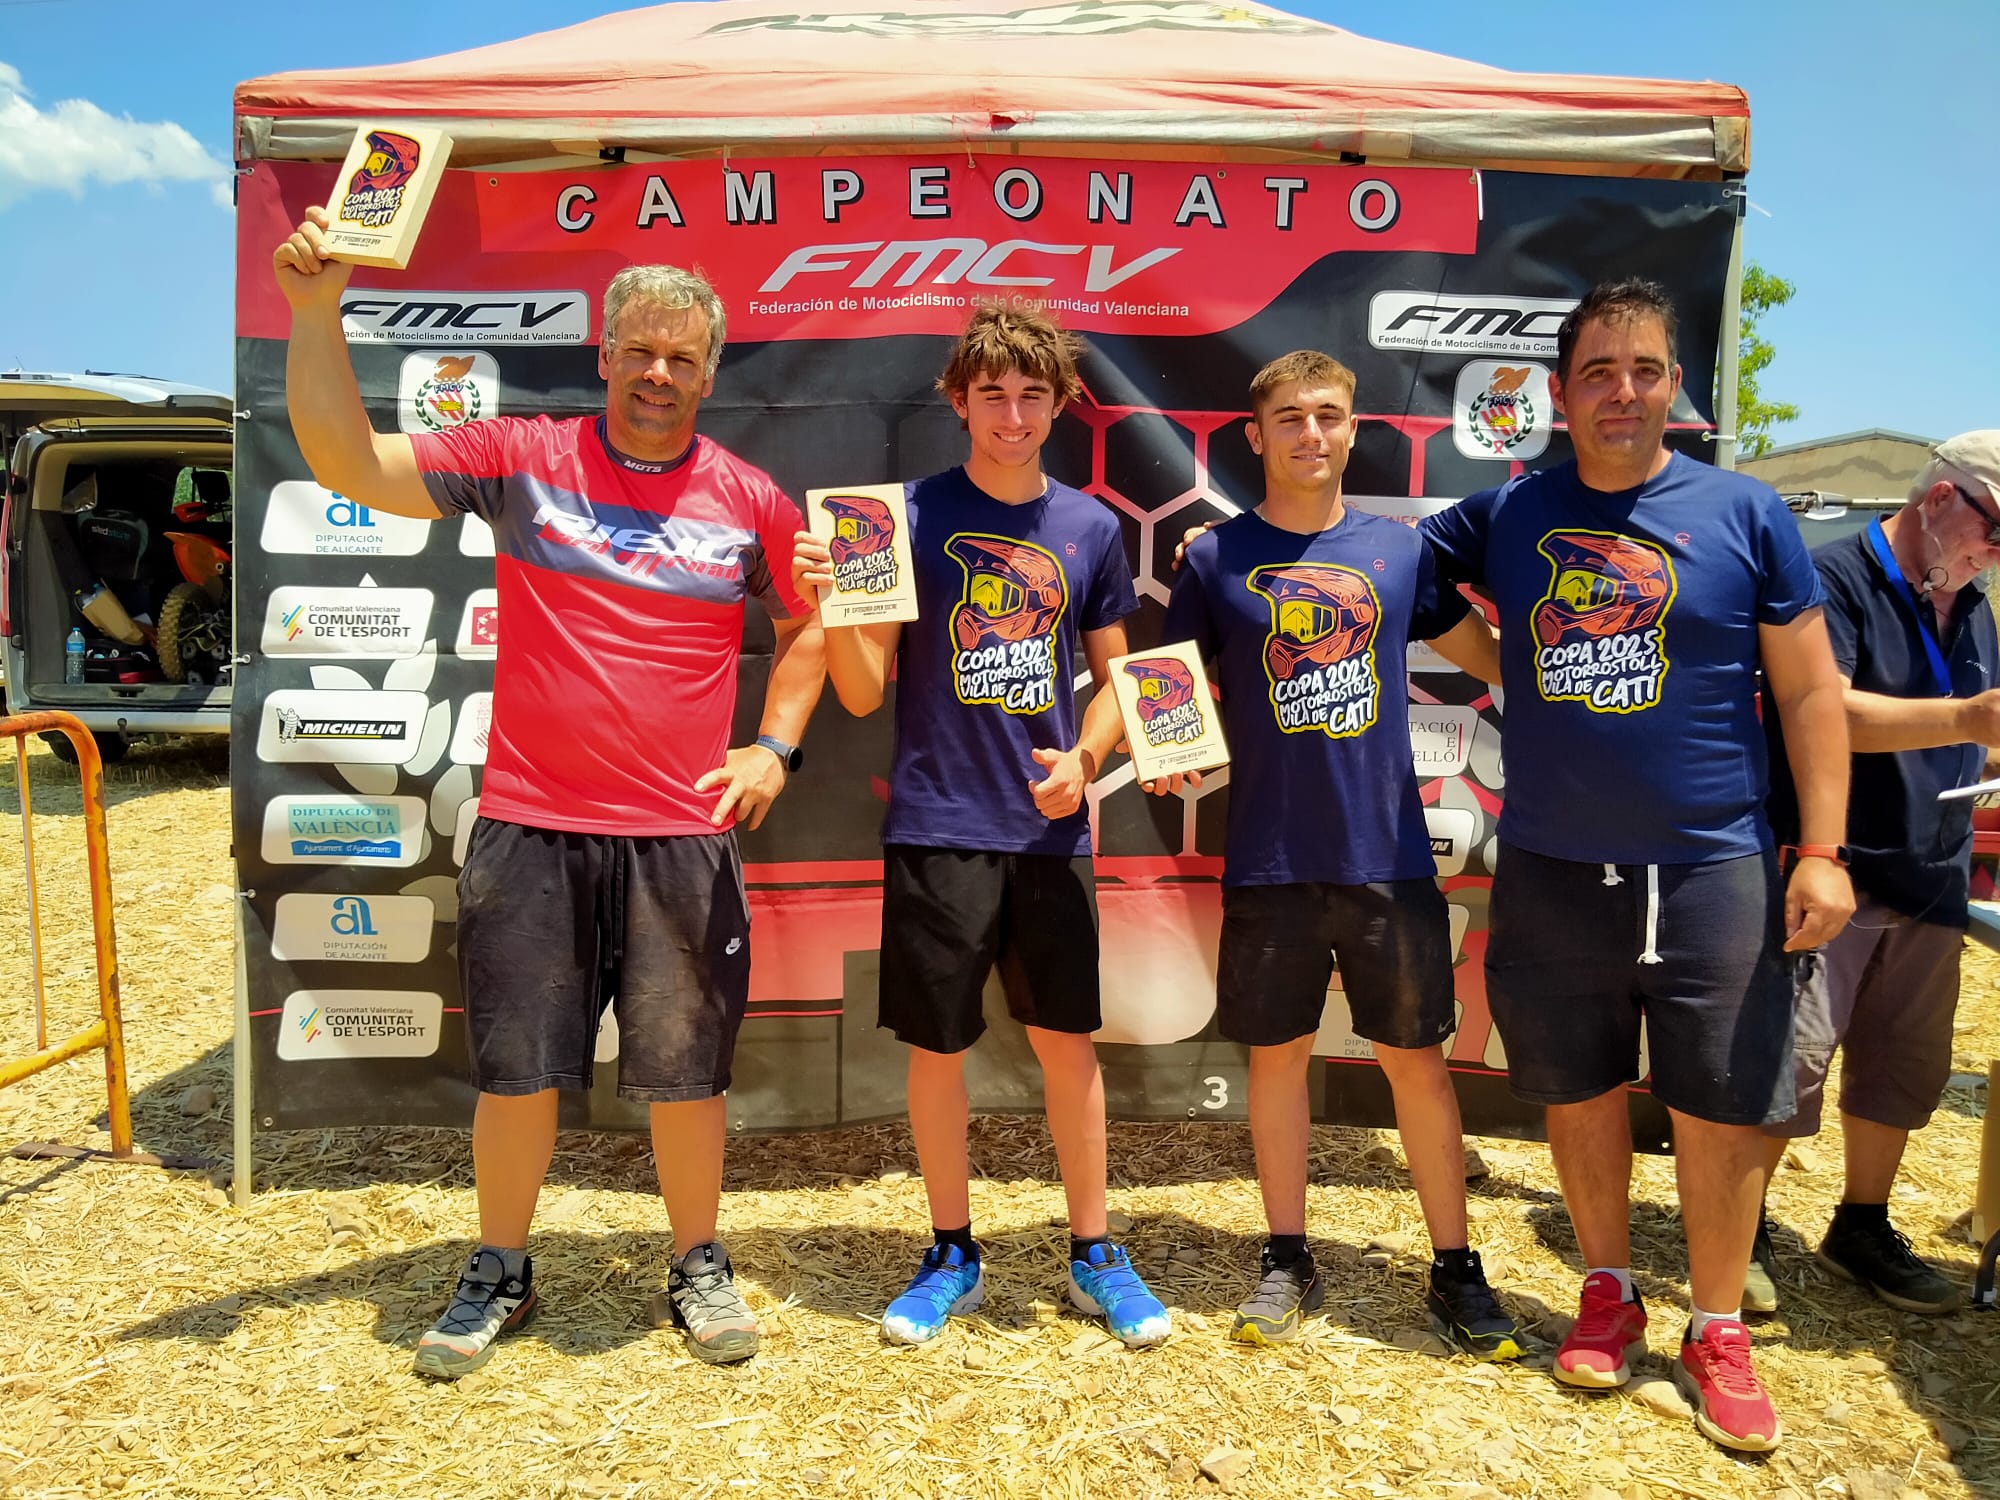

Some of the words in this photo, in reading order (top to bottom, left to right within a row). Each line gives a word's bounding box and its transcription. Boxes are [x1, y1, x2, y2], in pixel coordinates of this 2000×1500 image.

[344, 191, 373, 205] COPA
[374, 186, 404, 202] 2025
[555, 166, 1401, 233] CAMPEONATO
[758, 238, 1184, 292] FMCV
[749, 297, 834, 315] Federación
[839, 297, 858, 310] de
[862, 292, 965, 310] Motociclismo
[1012, 295, 1100, 314] Comunidad
[1104, 300, 1189, 317] Valenciana
[340, 300, 576, 328] FMCV
[1385, 305, 1573, 338] FMC
[344, 331, 370, 340] ación
[373, 331, 385, 339] de
[387, 332, 450, 341] Motociclismo
[452, 332, 464, 341] de
[466, 332, 474, 341] la
[477, 332, 529, 341] Comunidad
[533, 332, 580, 341] Valenciana
[1378, 335, 1428, 346] Federación
[1431, 338, 1442, 347] de
[1445, 339, 1507, 350] Motociclismo
[1509, 341, 1521, 351] de
[1523, 342, 1531, 351] la
[433, 382, 465, 394] FMCV
[623, 459, 662, 473] MOTS
[315, 534, 383, 543] DIPUTACIÓN
[835, 558, 864, 576] COPA
[865, 547, 894, 569] 2025
[355, 605, 400, 613] Valenciana
[308, 614, 399, 625] COMUNITAT
[315, 627, 336, 638] DE
[340, 626, 411, 638] L'ESPORT
[957, 645, 1008, 672] COPA
[1009, 636, 1053, 667] 2025
[1539, 641, 1593, 668] COPA
[1597, 629, 1659, 661] 2025
[959, 659, 1053, 687] MOTORROSTOLL
[1275, 670, 1325, 702] COPA
[1325, 652, 1371, 690] 2025
[1542, 654, 1663, 684] MOTORROSTOLL
[961, 682, 990, 698] VILA
[991, 682, 1007, 697] DE
[1542, 680, 1572, 694] VILA
[1574, 679, 1593, 694] DE
[1592, 668, 1661, 708] CATÍ
[1279, 676, 1376, 717] MOTORROSTOLL
[1145, 715, 1170, 733] COPA
[1170, 700, 1197, 721] 2025
[1281, 710, 1310, 728] VILA
[1312, 709, 1328, 724] DE
[301, 723, 403, 735] MICHELIN
[1409, 720, 1457, 734] TACIÓ
[1413, 749, 1456, 763] ELLÓ
[293, 819, 397, 834] VALÈNCIA
[323, 941, 388, 950] DIPUTACIÓN
[325, 951, 340, 960] DE
[341, 951, 388, 960] ALICANTE
[325, 1006, 368, 1014] Comunitat
[325, 1015, 413, 1026] COMUNITAT
[333, 1027, 352, 1037] DE
[357, 1026, 425, 1037] L'ESPORT
[1202, 1076, 1229, 1110] 3
